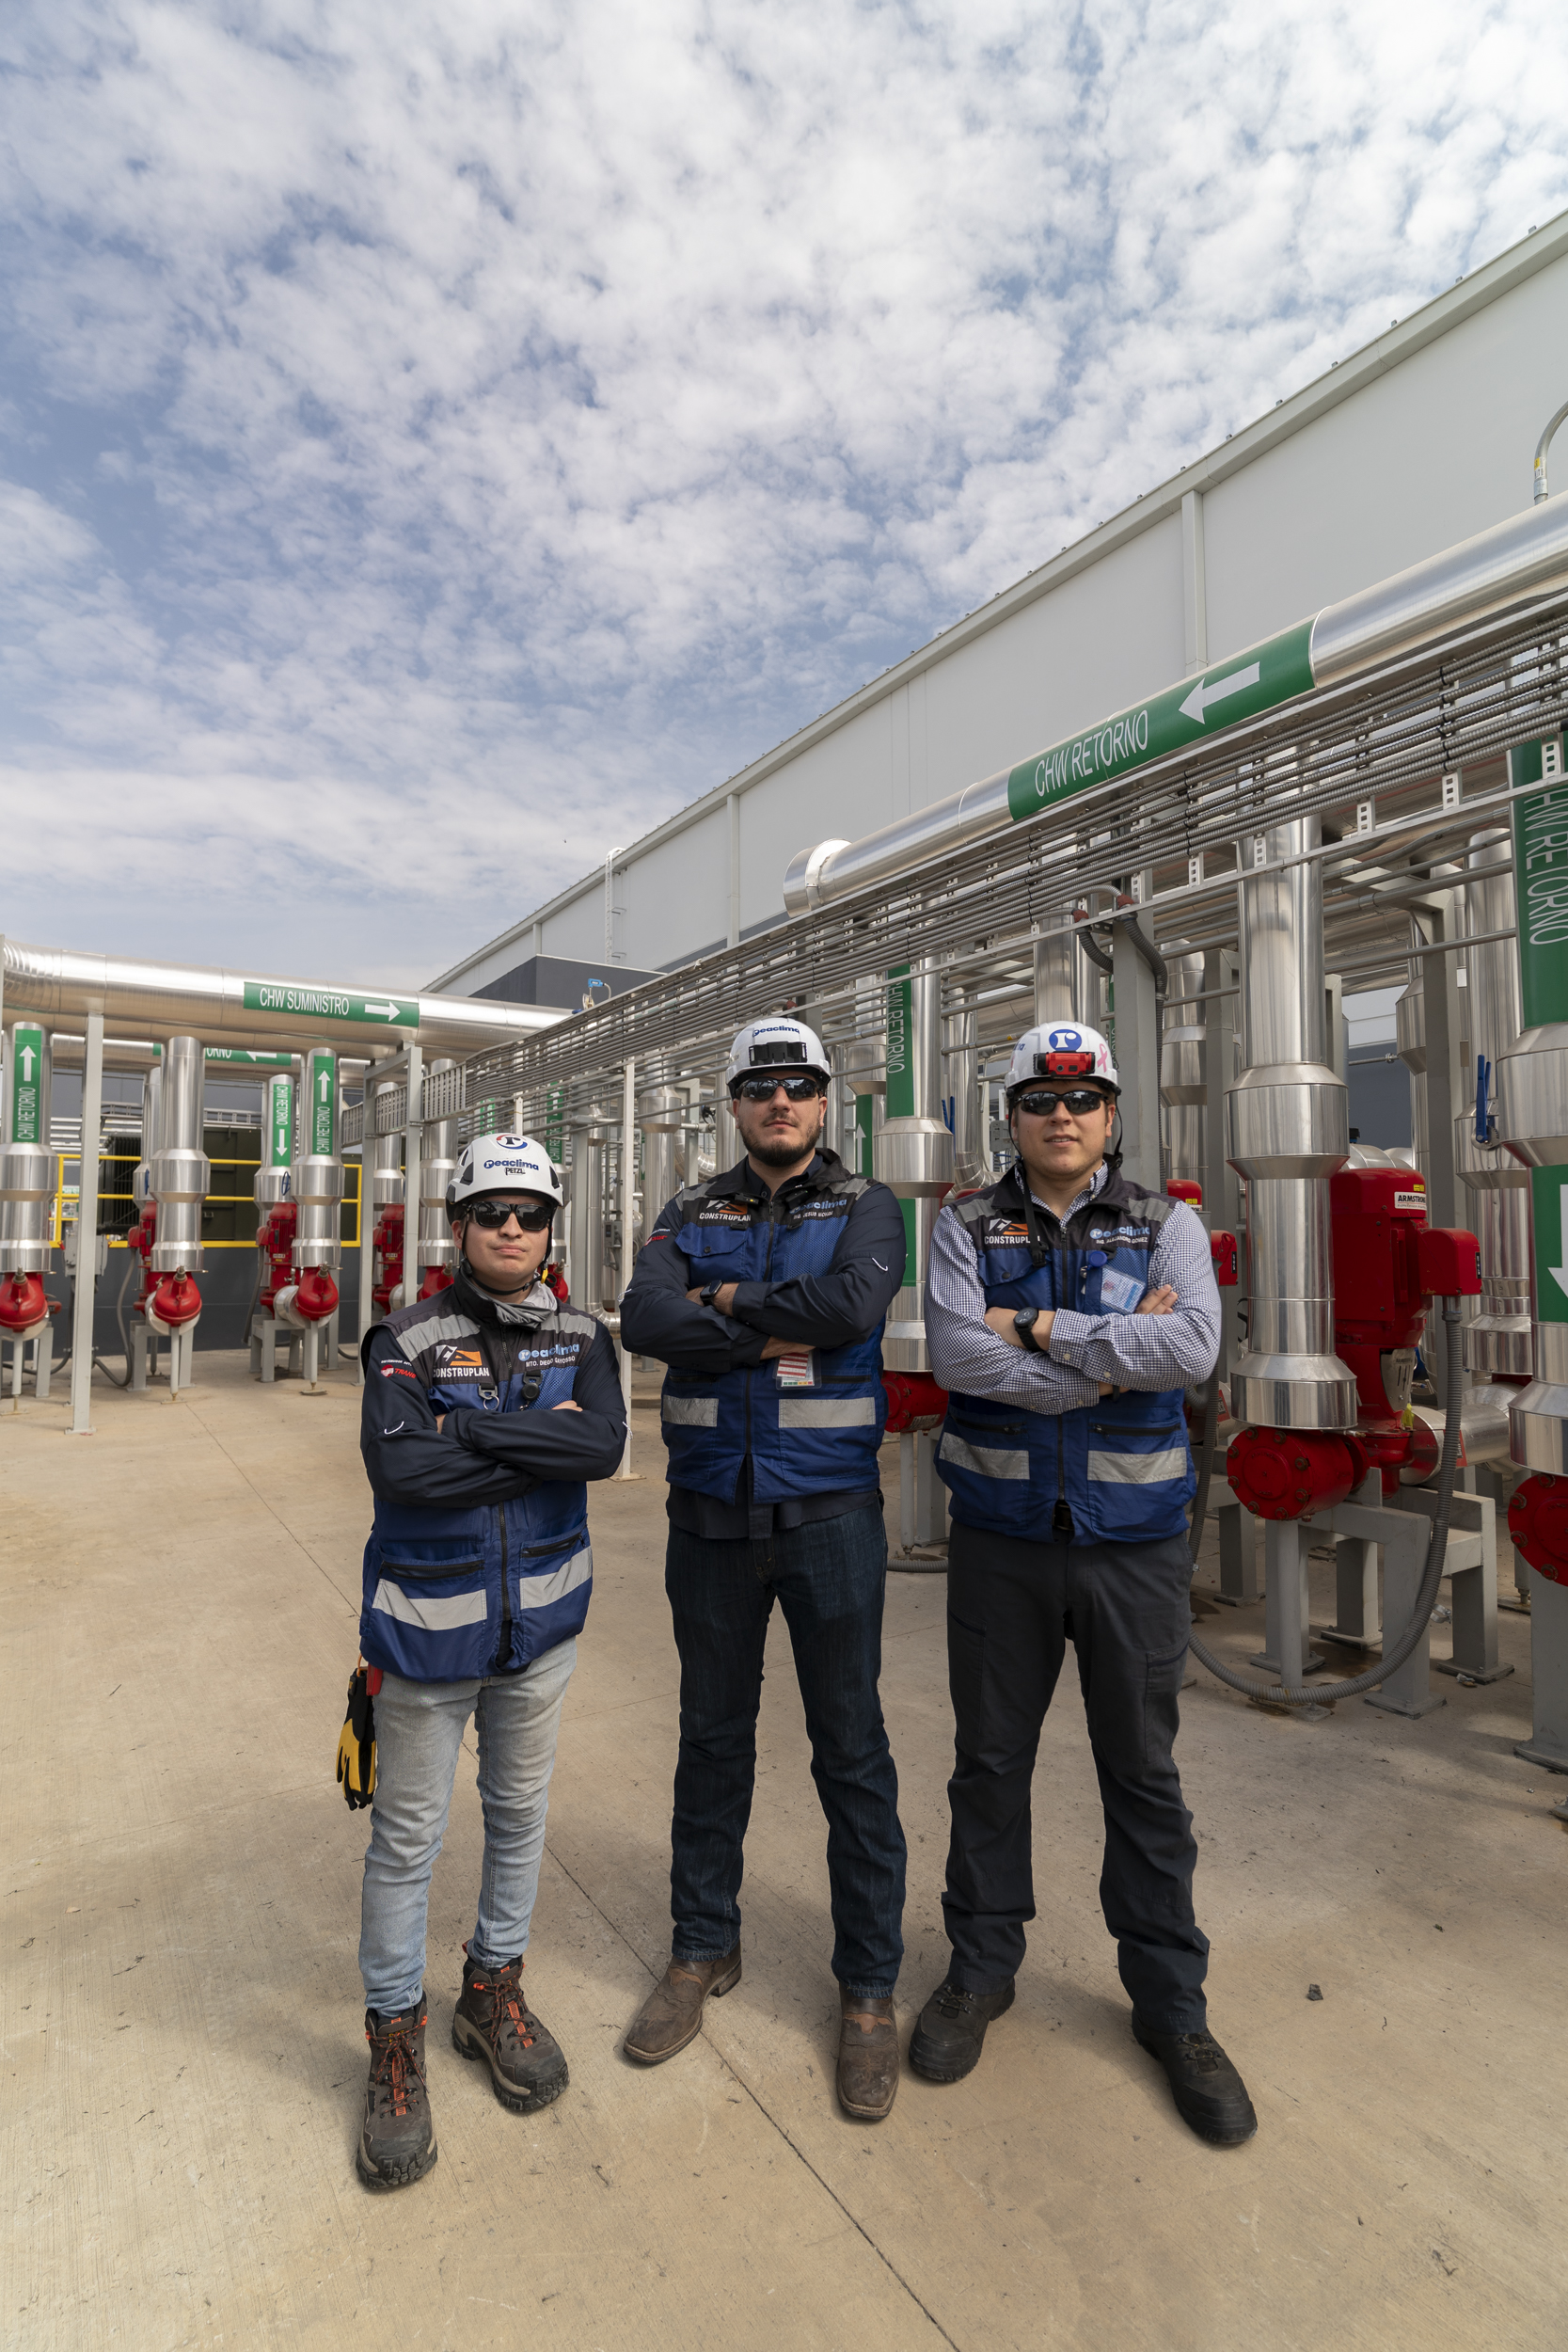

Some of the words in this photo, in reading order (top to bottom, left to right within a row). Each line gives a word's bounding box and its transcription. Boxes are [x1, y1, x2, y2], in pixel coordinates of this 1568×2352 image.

[1035, 746, 1070, 797] CHW
[1071, 709, 1148, 782] RETORNO
[1524, 787, 1568, 832] HW
[259, 987, 285, 1009] CHW
[286, 990, 350, 1016] SUMINISTRO
[887, 982, 904, 1008] HW
[886, 1009, 906, 1074] RETORNO
[18, 1087, 36, 1122] RETORNO
[277, 1085, 289, 1100] CHW
[277, 1100, 289, 1126] RETORNO
[316, 1105, 331, 1136] RETORNO
[17, 1122, 35, 1139] CHW
[316, 1136, 330, 1153] CHW
[483, 1158, 540, 1171] reaclima
[699, 1211, 752, 1222] CONSTRUPLAN
[518, 1343, 580, 1362] reaclima
[432, 1366, 490, 1378] CONSTRUPLAN
